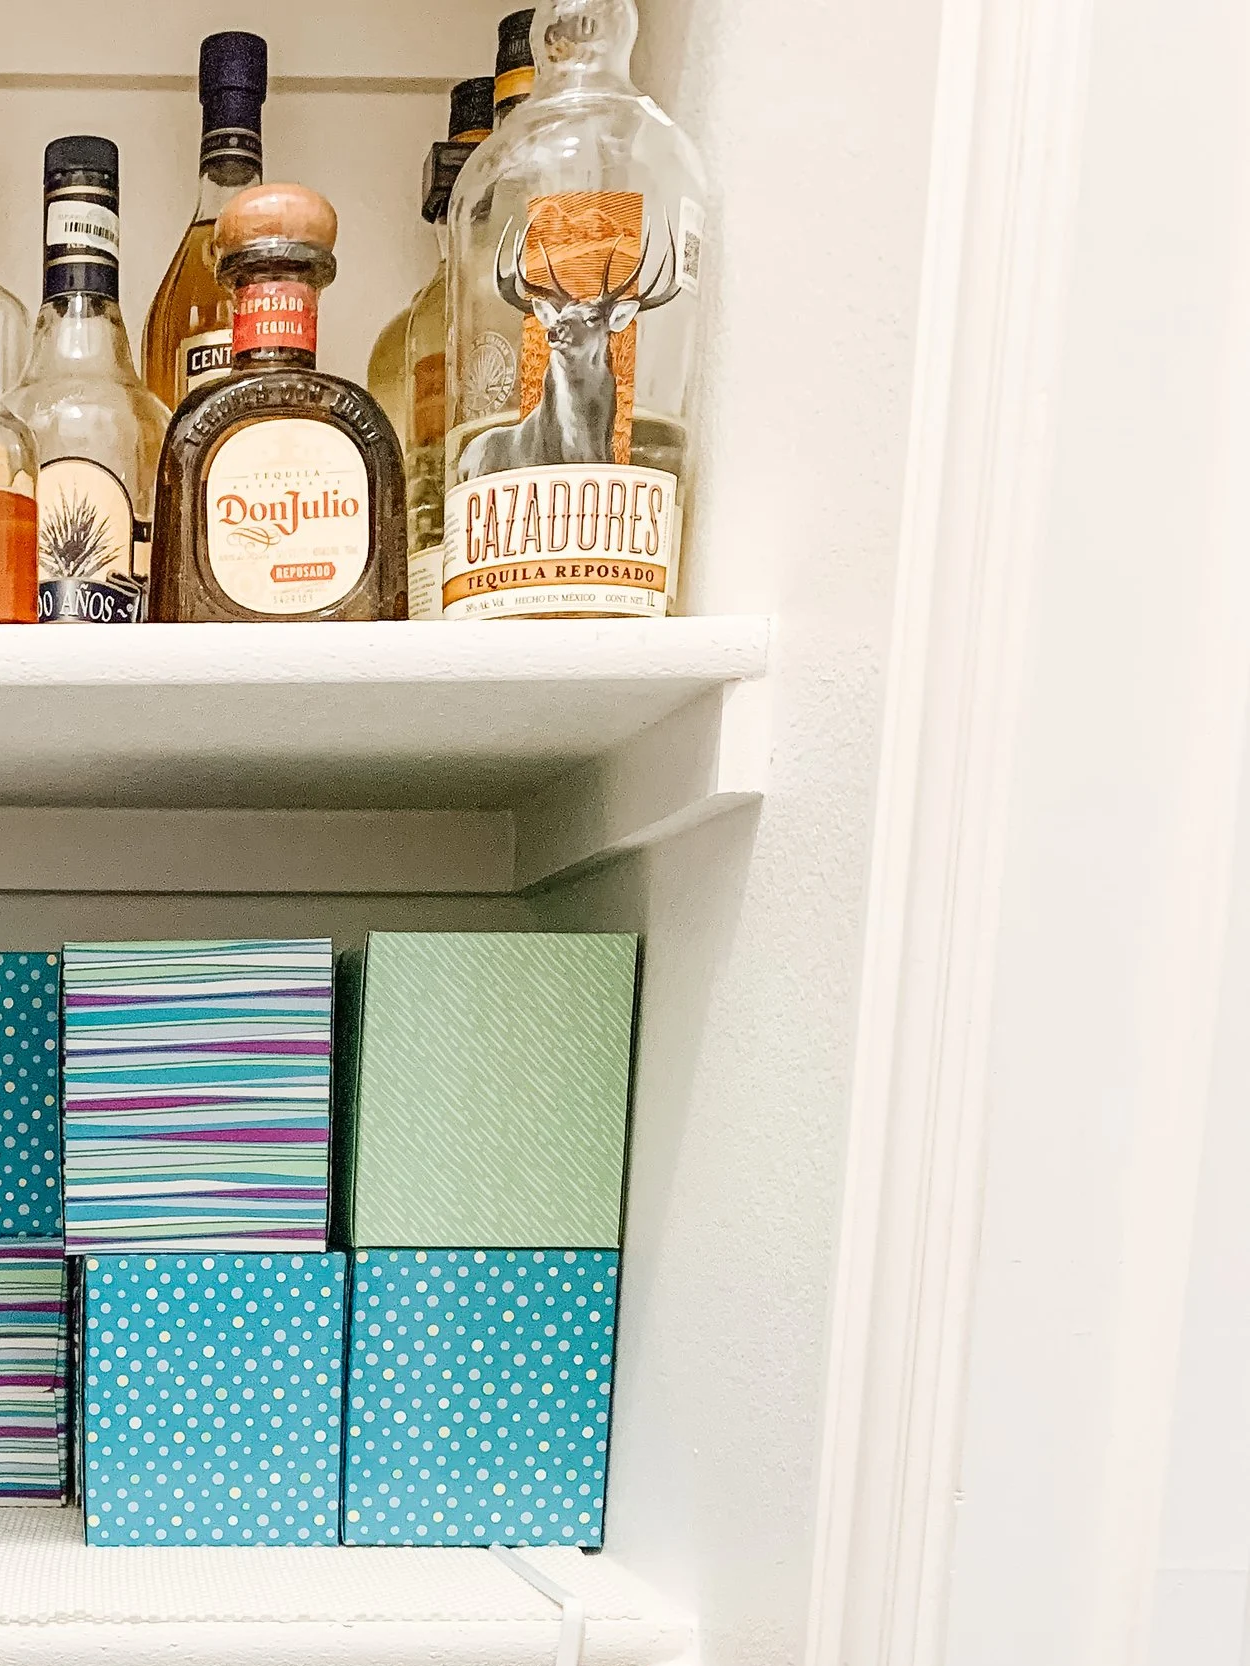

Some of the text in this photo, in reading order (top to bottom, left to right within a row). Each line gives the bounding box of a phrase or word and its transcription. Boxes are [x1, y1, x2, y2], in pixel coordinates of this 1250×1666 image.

[240, 296, 304, 315] REPOSADO
[255, 321, 303, 336] TEQUILA
[191, 346, 232, 371] CENT
[253, 469, 321, 480] TEQUILA
[466, 479, 663, 564] CAZADORES
[275, 564, 332, 580] REPOSADO
[467, 564, 655, 590] TEQUILA REPOSADO
[59, 583, 115, 623] AÑOS
[515, 595, 546, 605] HECHO
[547, 595, 559, 603] EN
[561, 592, 596, 602] MÉXICO
